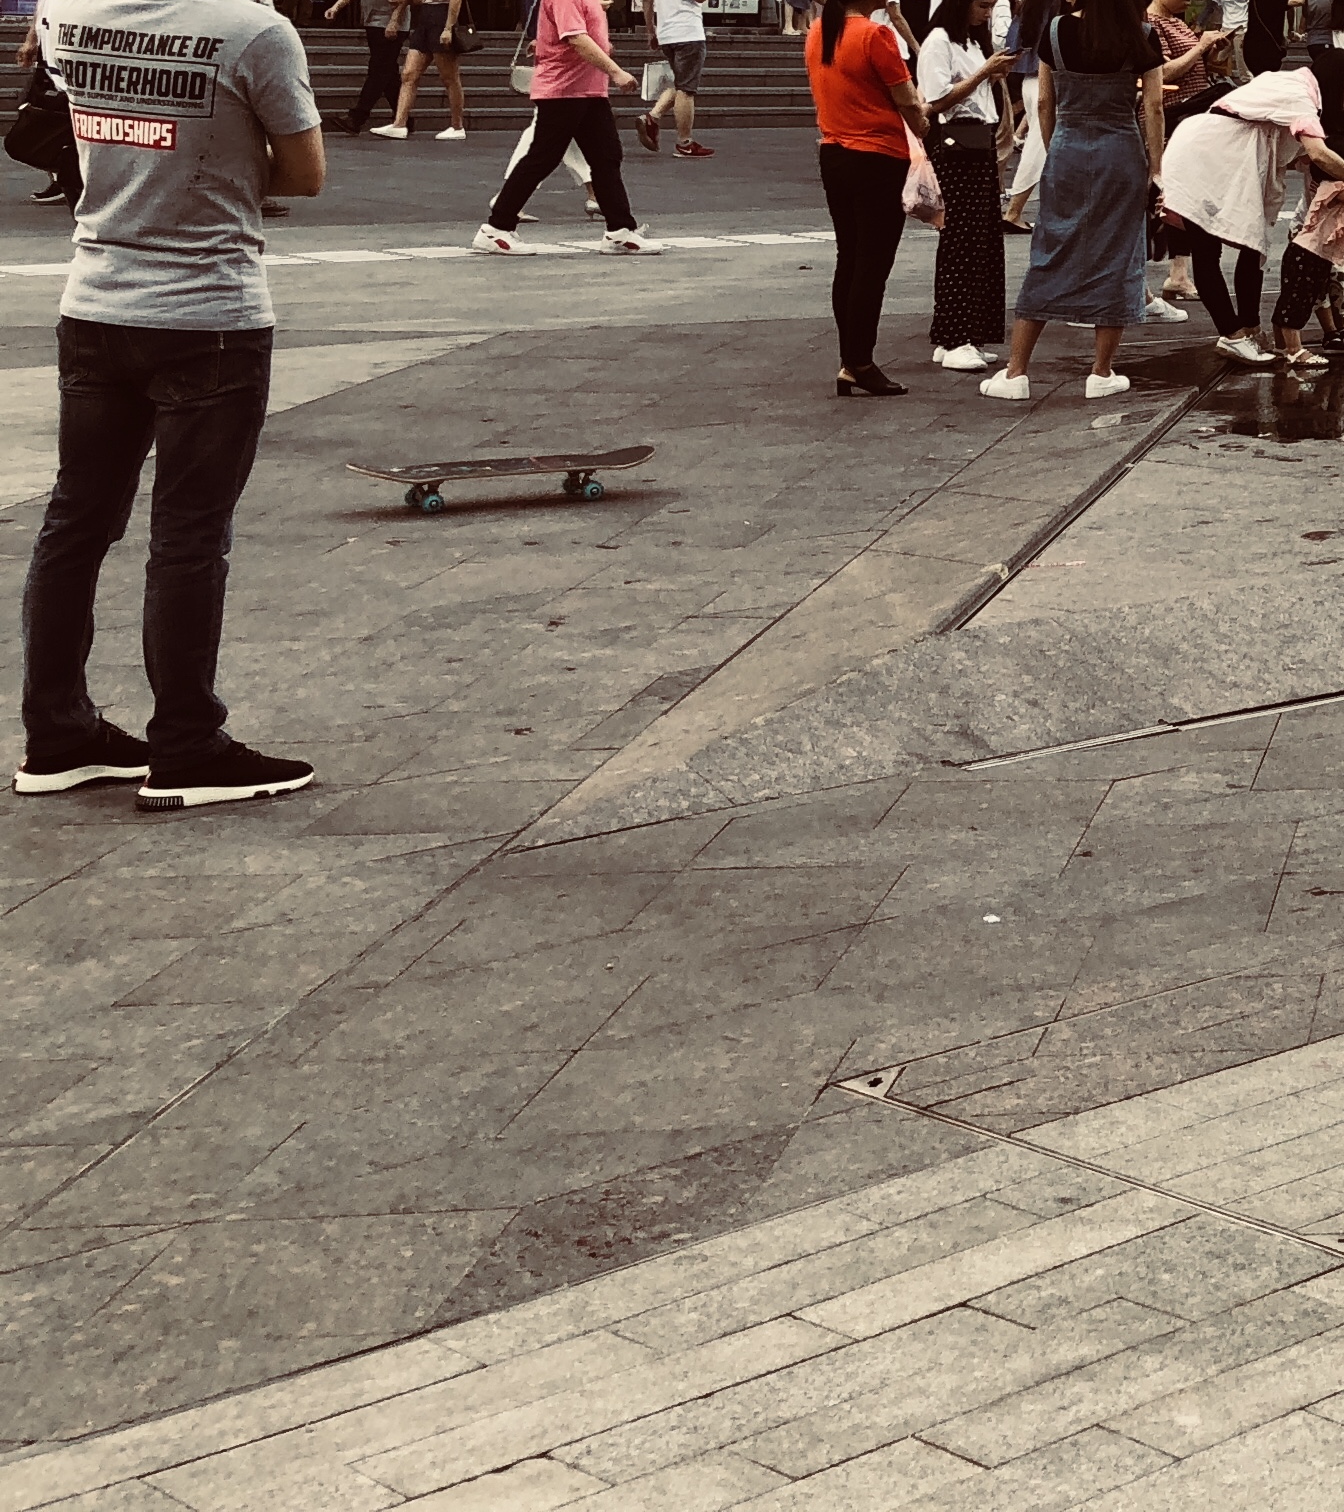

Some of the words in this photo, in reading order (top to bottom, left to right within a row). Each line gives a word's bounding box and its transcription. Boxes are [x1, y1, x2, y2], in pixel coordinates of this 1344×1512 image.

[58, 23, 78, 46] THE
[78, 25, 193, 58] IMPORTANCE
[193, 37, 225, 60] OF
[57, 58, 208, 101] ROTHERHOOD
[87, 92, 119, 102] SUPPORT
[119, 96, 135, 104] AND
[73, 113, 173, 147] FRIENDSHIPS
